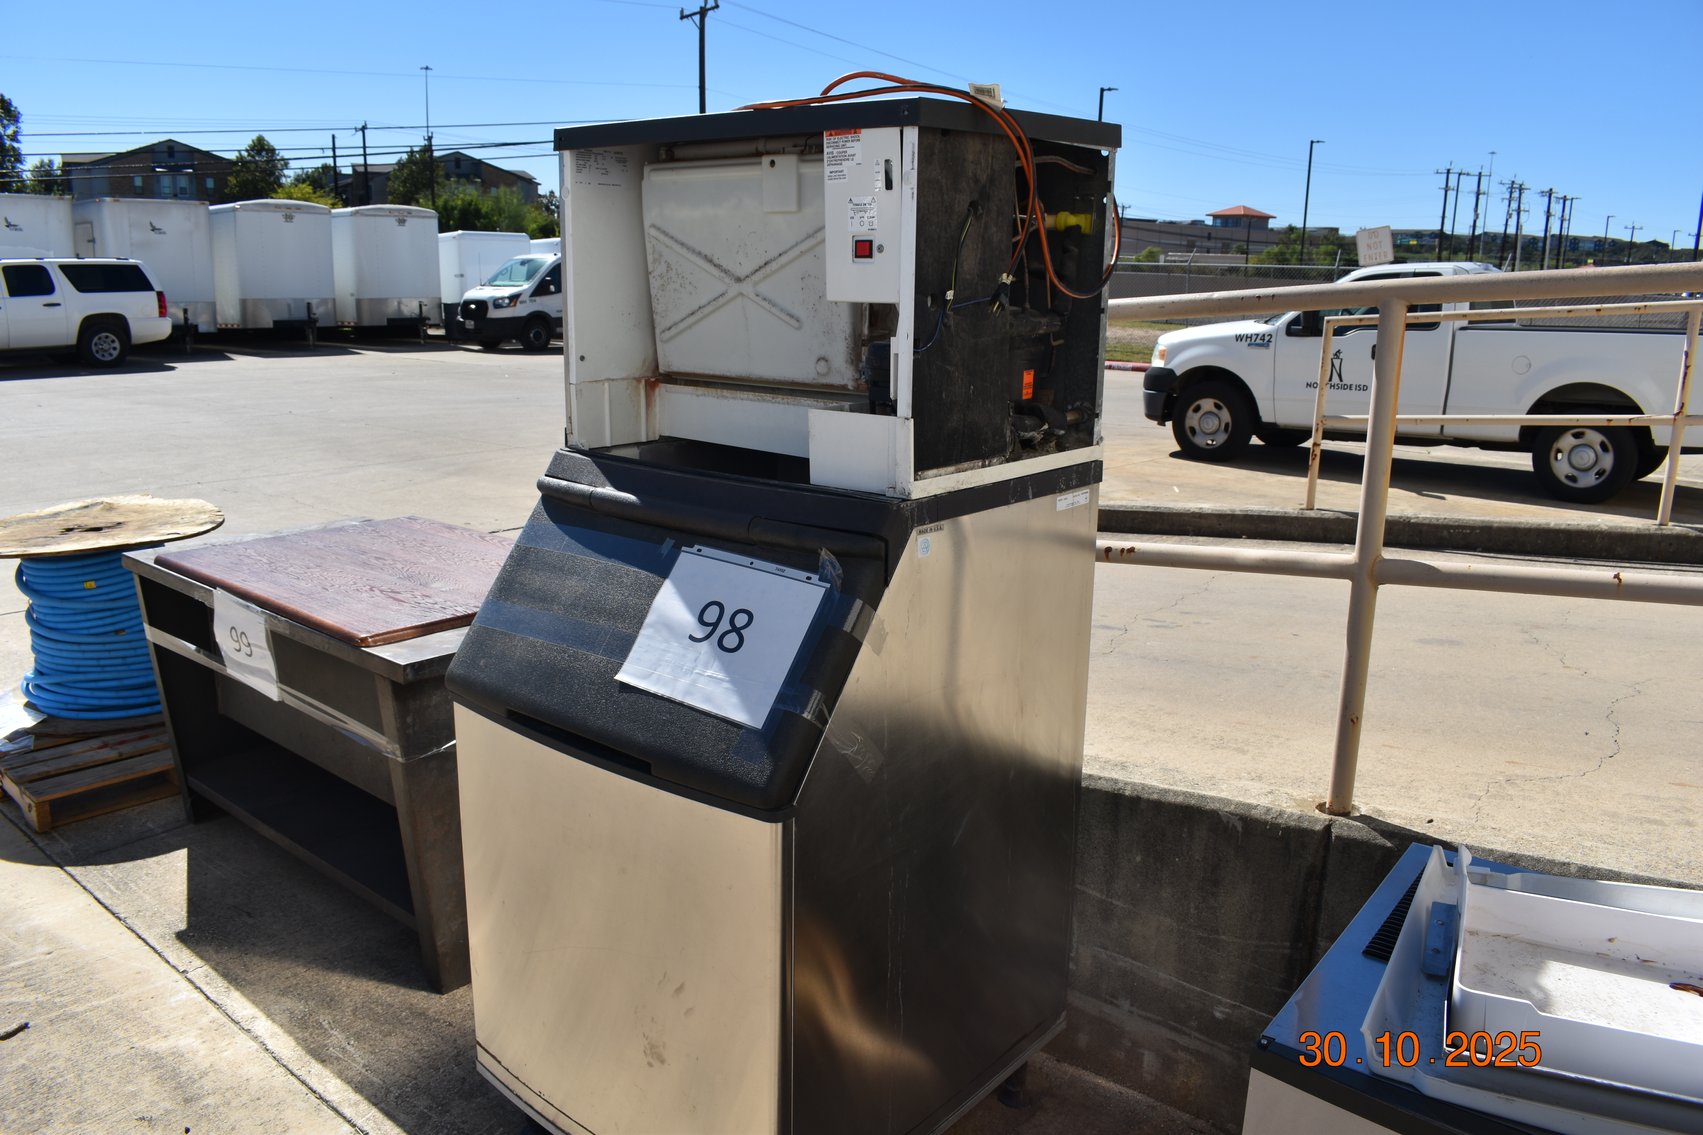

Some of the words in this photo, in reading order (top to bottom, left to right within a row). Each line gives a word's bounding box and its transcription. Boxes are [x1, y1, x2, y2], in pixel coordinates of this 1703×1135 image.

[1366, 240, 1383, 251] NOT
[1235, 333, 1273, 343] WH742
[1305, 381, 1354, 391] NOHSIDE
[1354, 383, 1368, 392] ISD
[688, 600, 755, 654] 98
[229, 626, 253, 658] 99
